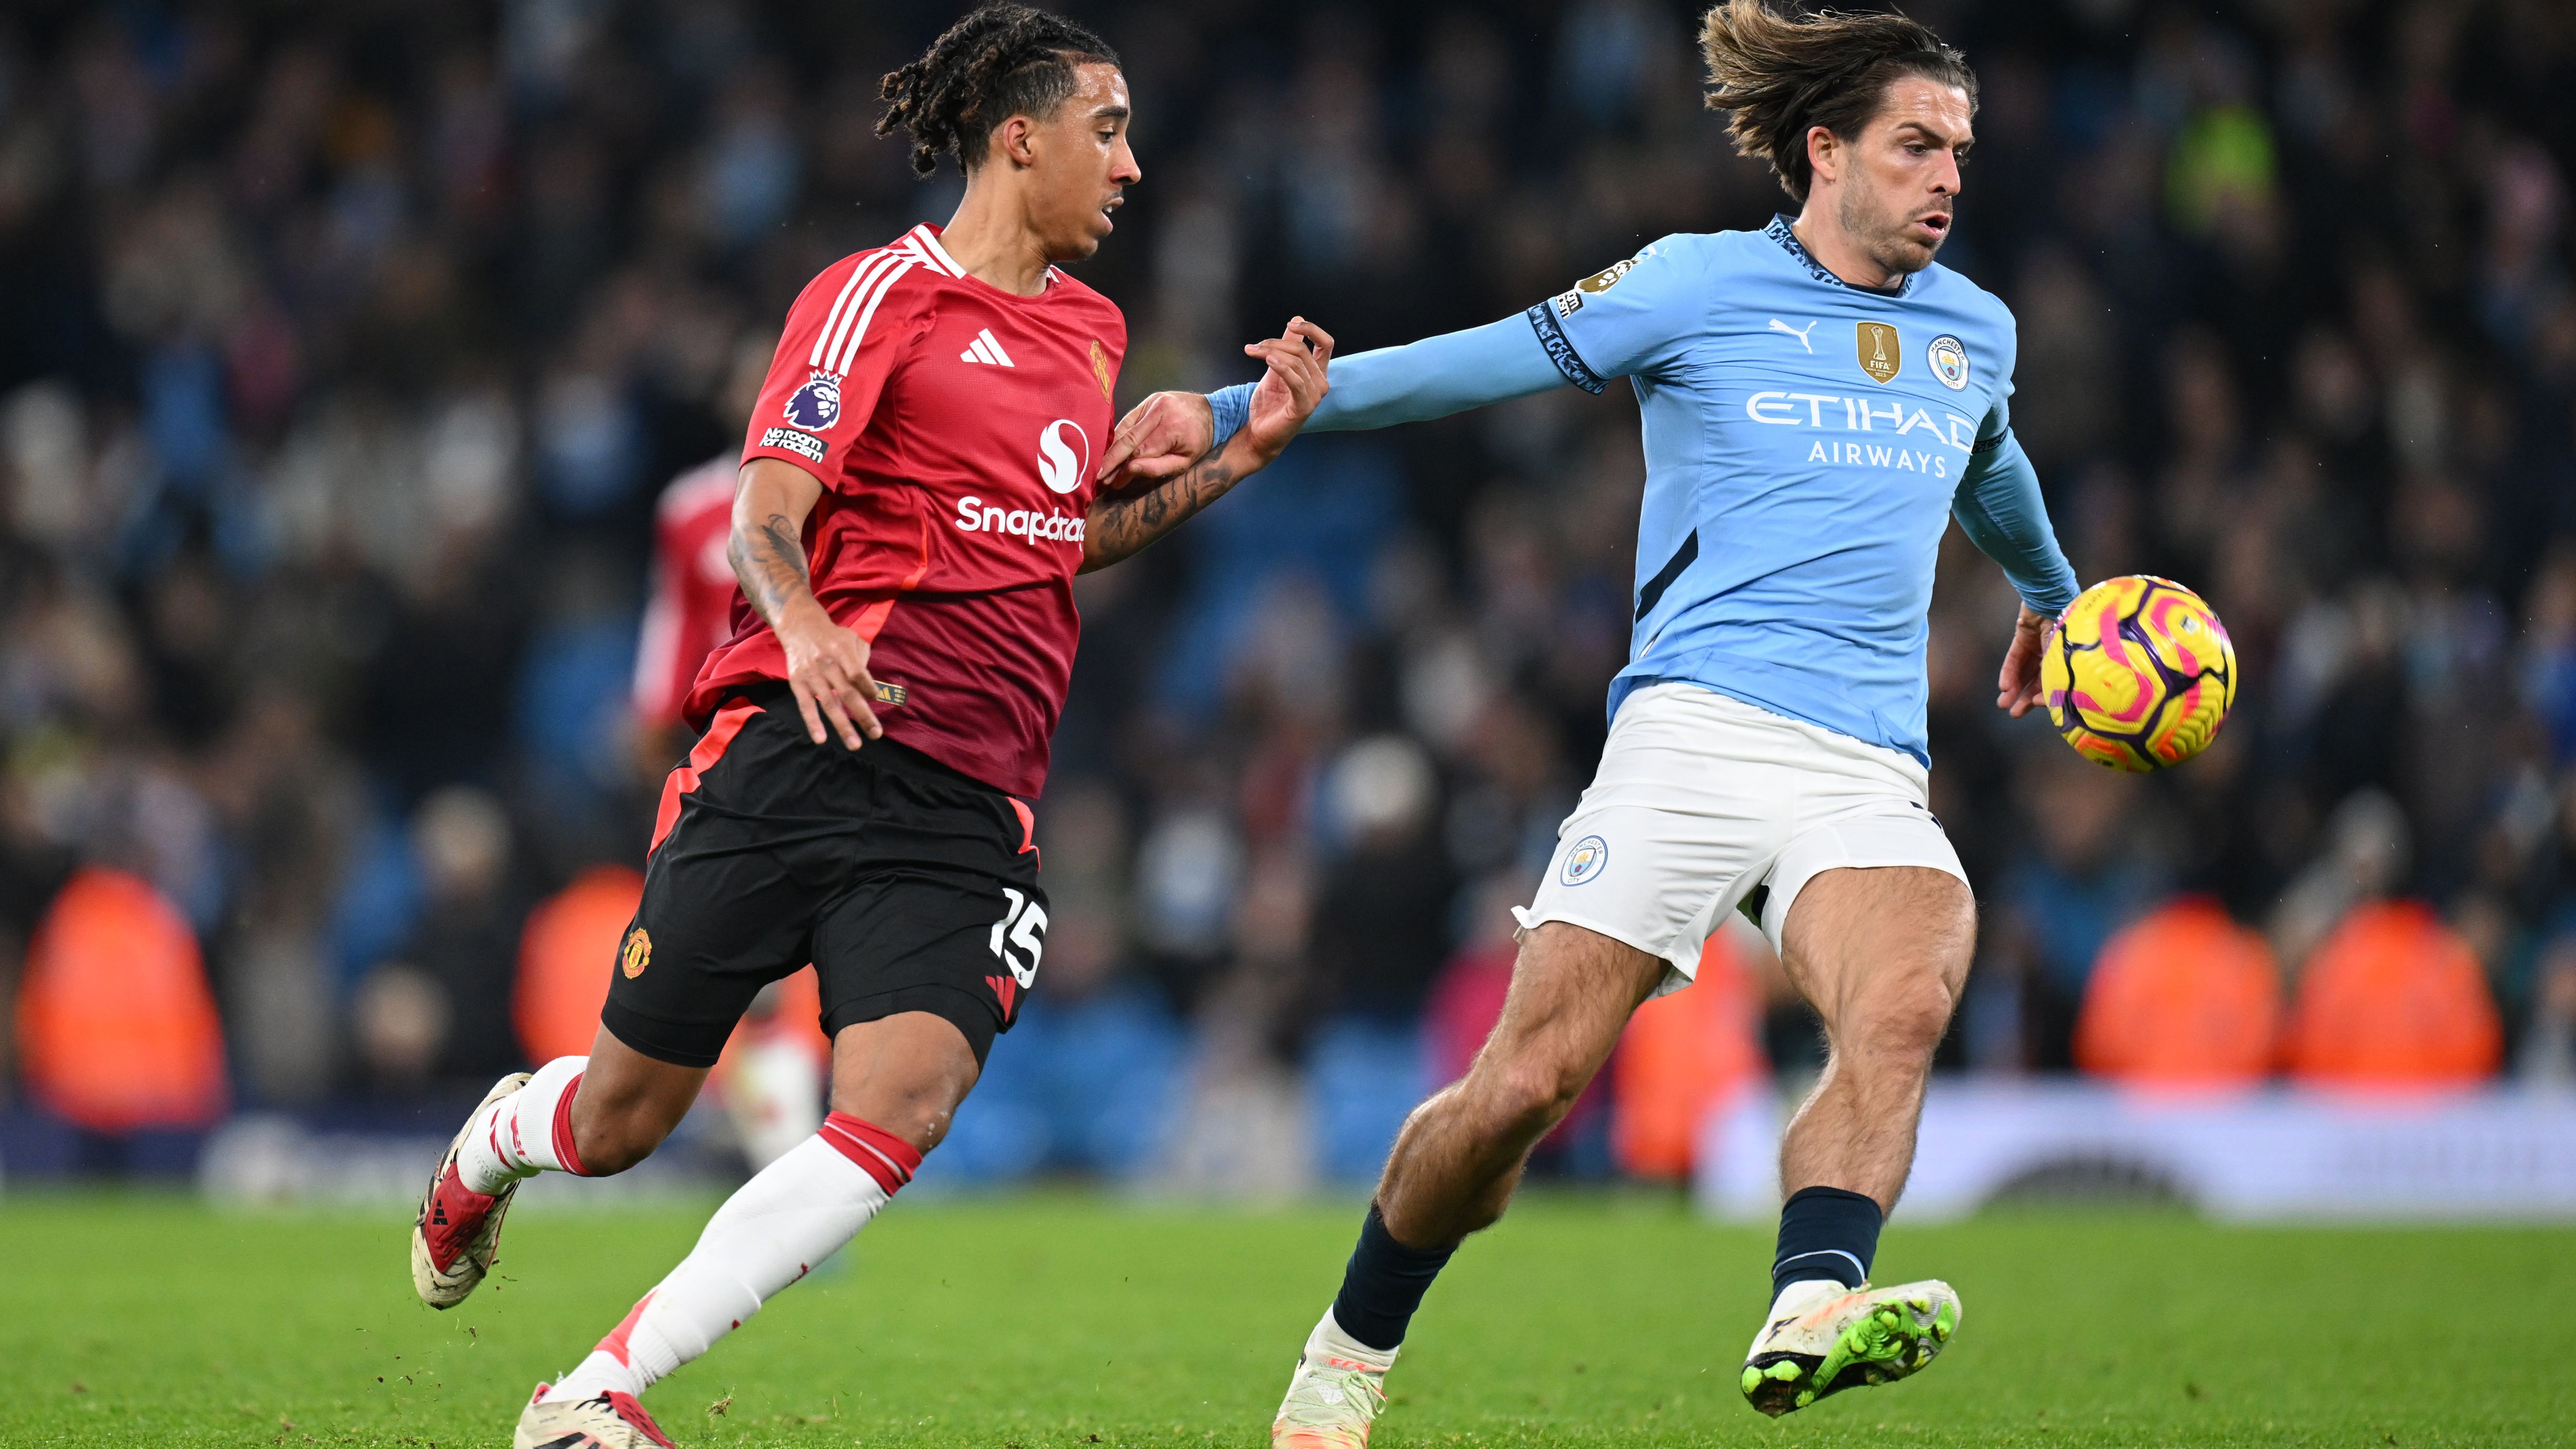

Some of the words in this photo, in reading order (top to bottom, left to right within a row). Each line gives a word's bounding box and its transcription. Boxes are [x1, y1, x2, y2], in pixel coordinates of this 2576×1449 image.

[1931, 339, 1965, 360] MANCHESTER
[1870, 360, 1889, 370] FIFA
[1746, 391, 1976, 455] ETIHAD
[759, 437, 779, 446] for
[778, 439, 823, 464] racism
[764, 427, 784, 438] No
[784, 430, 822, 451] room
[1808, 441, 1946, 478] AIRWAYS
[989, 887, 1048, 989] 15
